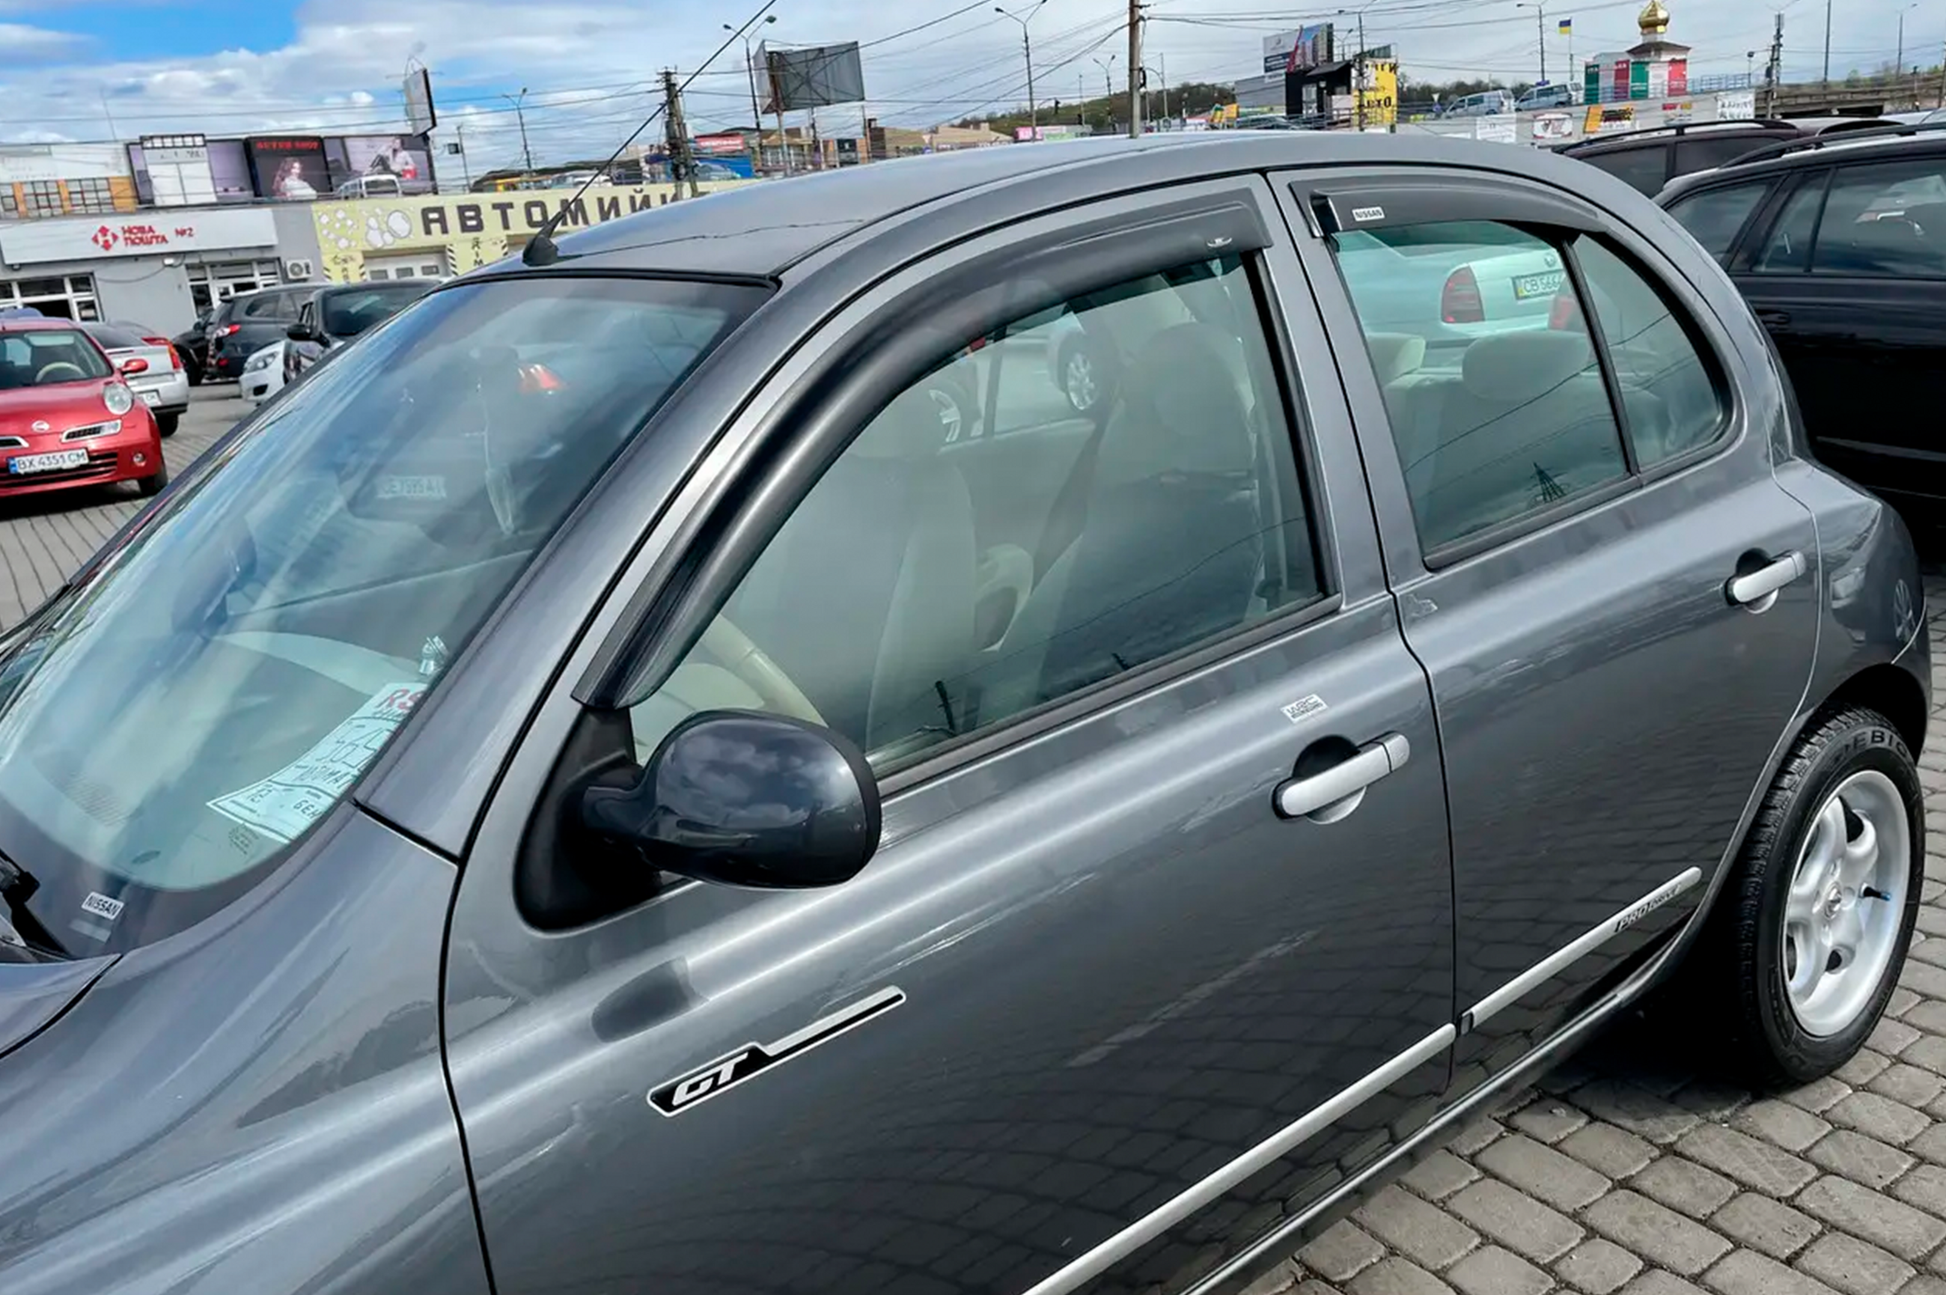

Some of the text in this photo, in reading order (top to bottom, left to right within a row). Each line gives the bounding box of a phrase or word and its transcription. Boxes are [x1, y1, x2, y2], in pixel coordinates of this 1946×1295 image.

[421, 188, 710, 235] АВТОМИЙ
[122, 226, 155, 235] НОВА
[124, 234, 168, 246] ПОШТА
[17, 457, 36, 470] BX
[68, 451, 86, 463] CM
[84, 894, 122, 917] NISSAN
[672, 1051, 749, 1106] GT
